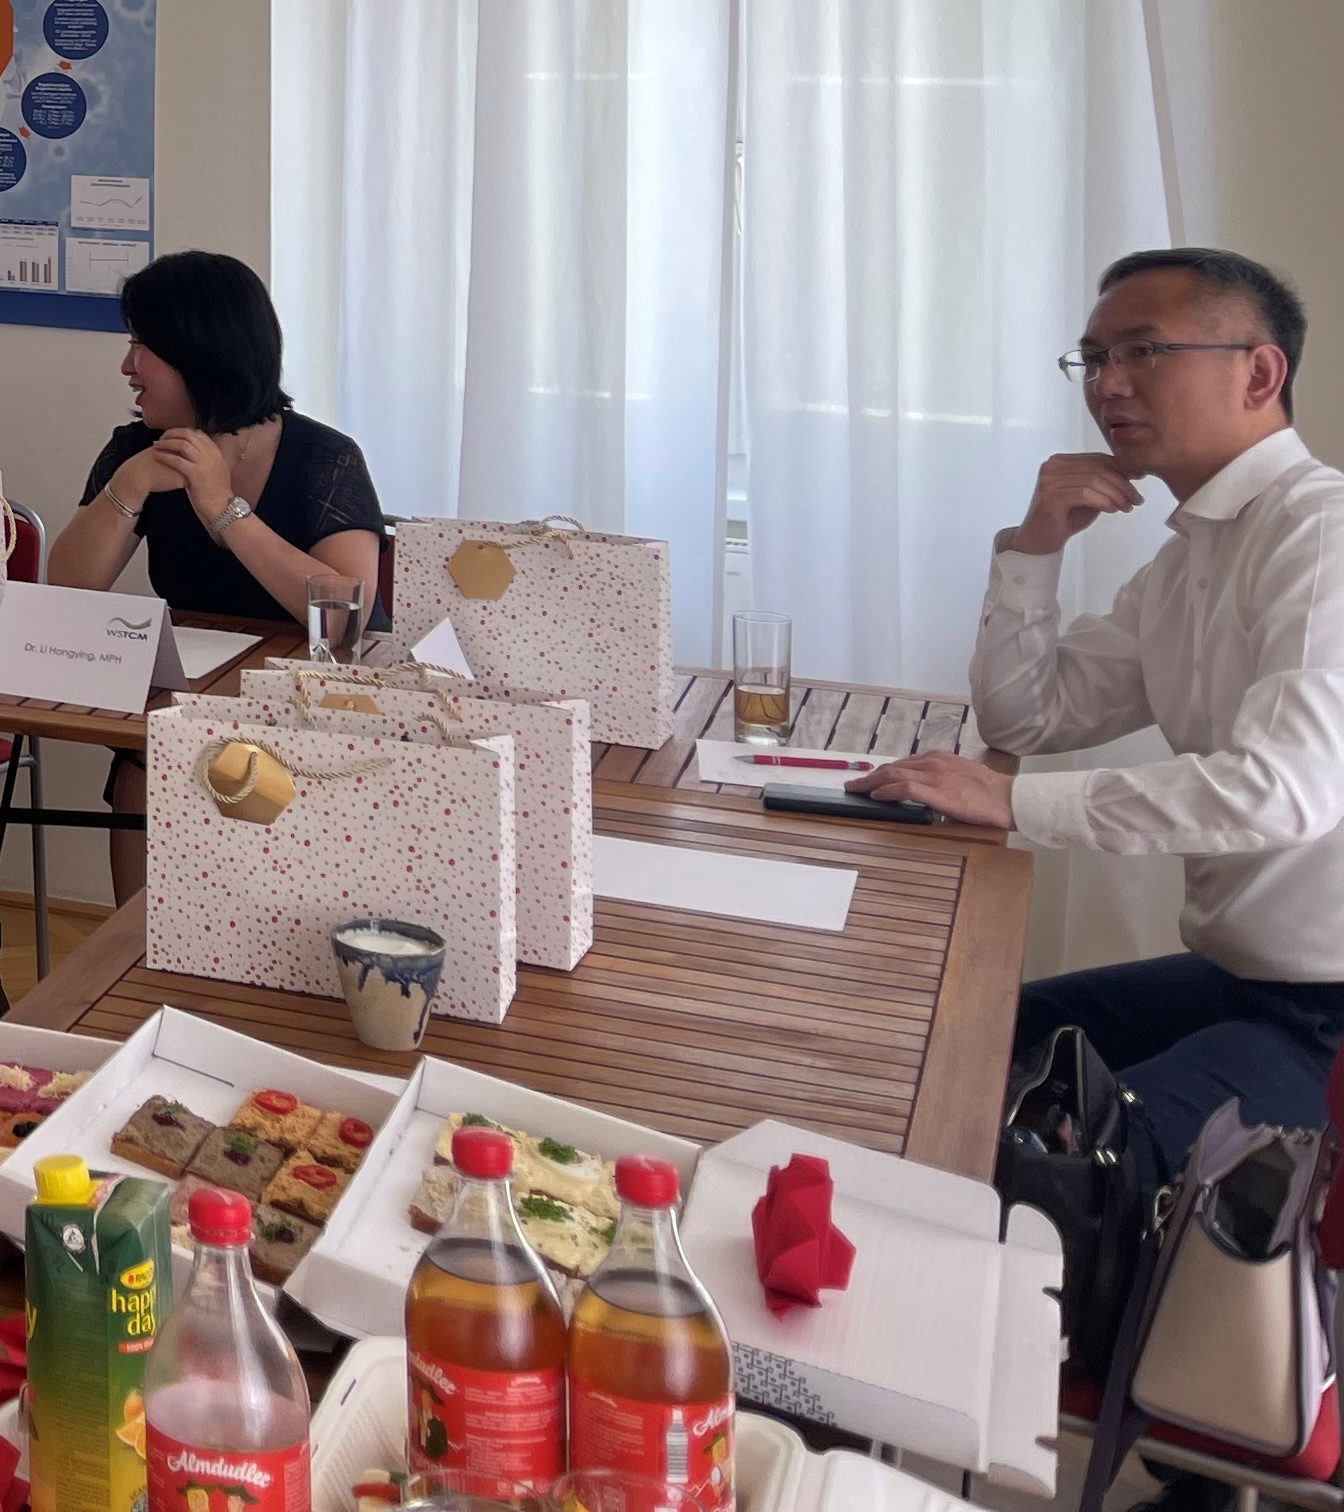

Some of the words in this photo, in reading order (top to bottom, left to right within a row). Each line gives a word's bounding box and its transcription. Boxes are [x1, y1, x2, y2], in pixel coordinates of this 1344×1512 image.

[106, 629, 148, 641] WSTCM
[24, 642, 38, 653] Dr.
[99, 653, 123, 665] MPH
[167, 1450, 272, 1488] Almdudler
